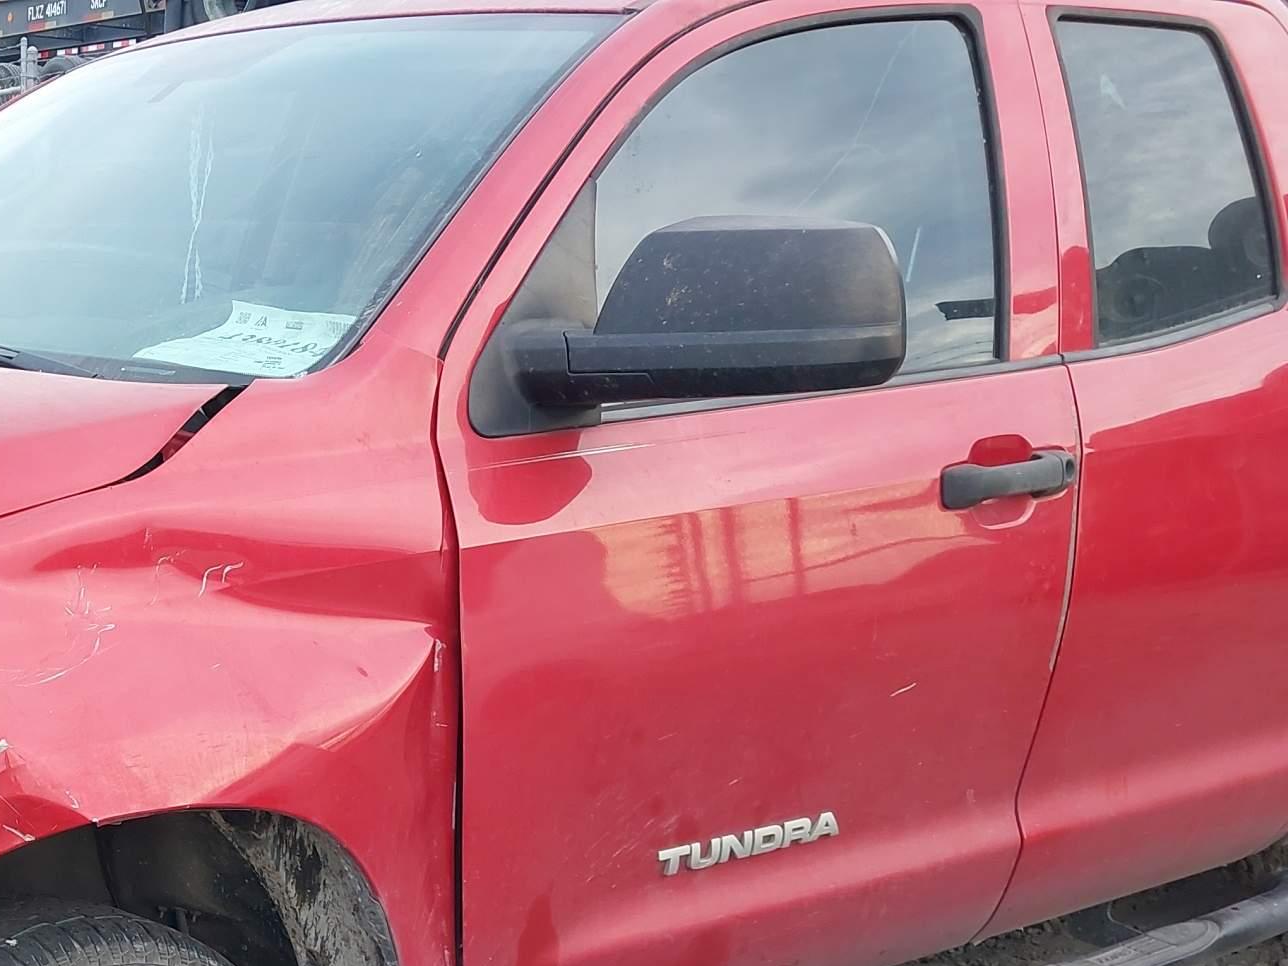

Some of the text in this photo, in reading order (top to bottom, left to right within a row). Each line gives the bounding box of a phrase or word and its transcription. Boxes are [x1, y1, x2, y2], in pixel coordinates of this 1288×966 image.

[27, 0, 67, 21] FLXZ 414671
[658, 811, 840, 876] TUNDRA
